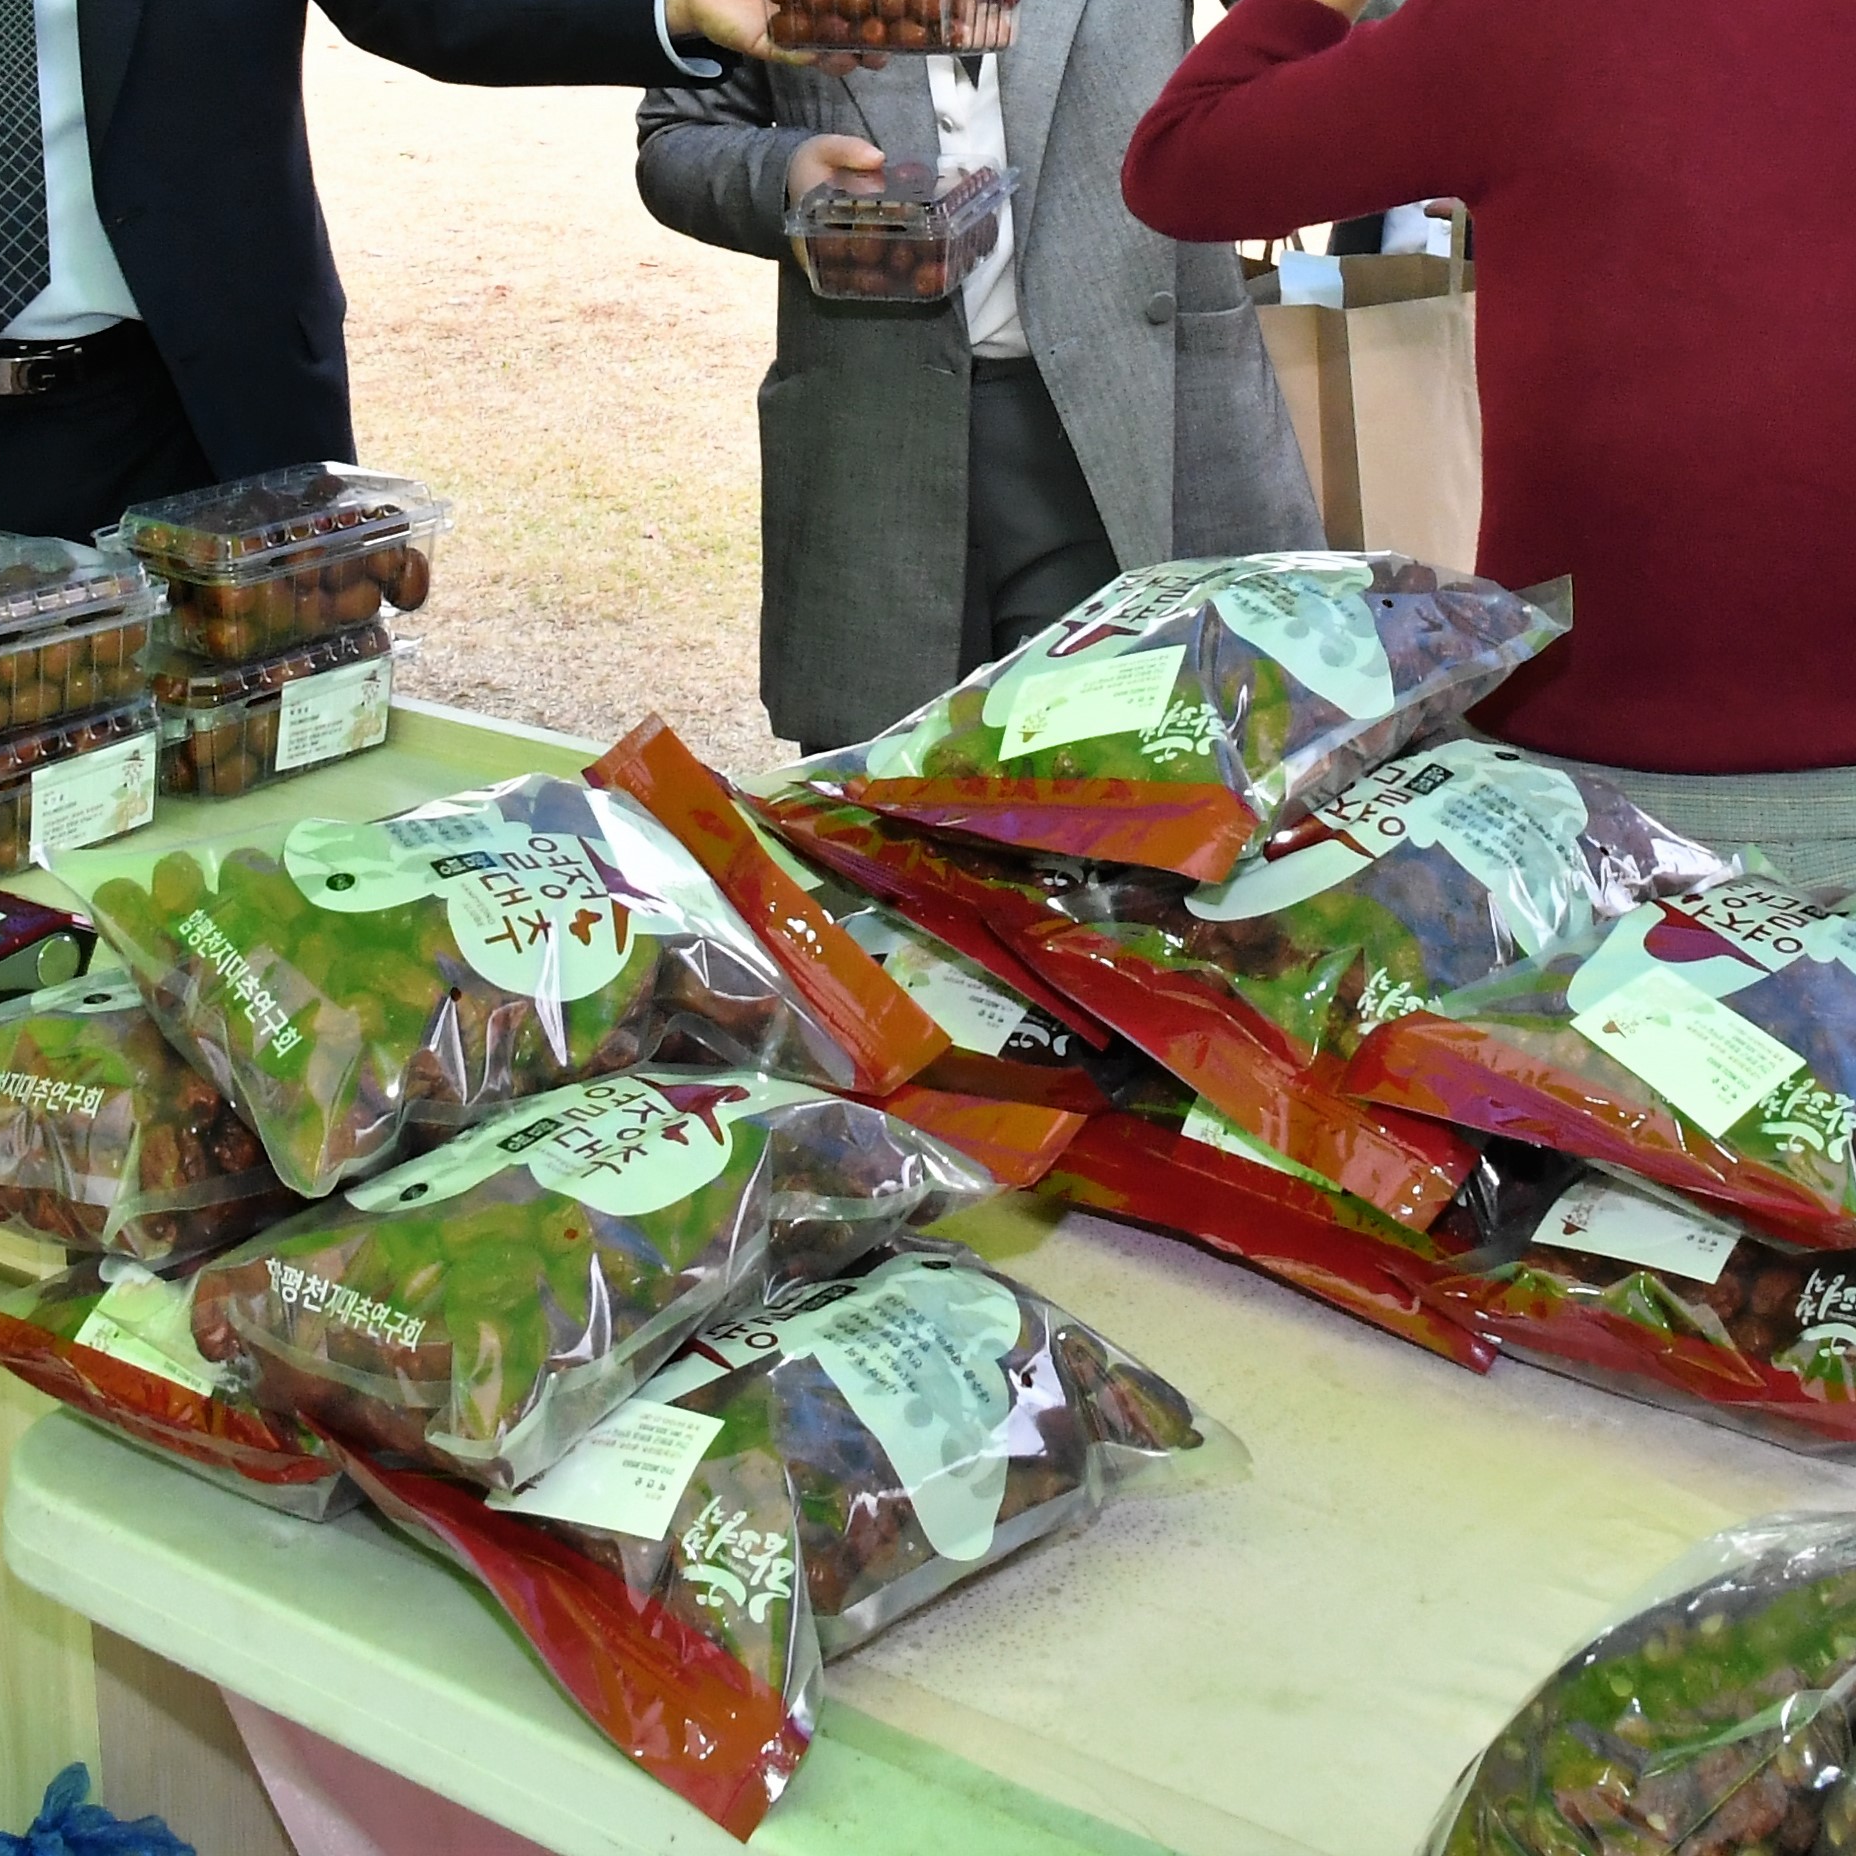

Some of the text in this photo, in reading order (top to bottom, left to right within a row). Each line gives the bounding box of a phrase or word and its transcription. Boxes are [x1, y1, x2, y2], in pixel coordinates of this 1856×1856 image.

[478, 870, 554, 955] 대추
[177, 907, 303, 1058] 함평천지대추연구회
[264, 1257, 427, 1354] 함평천지대추연구회
